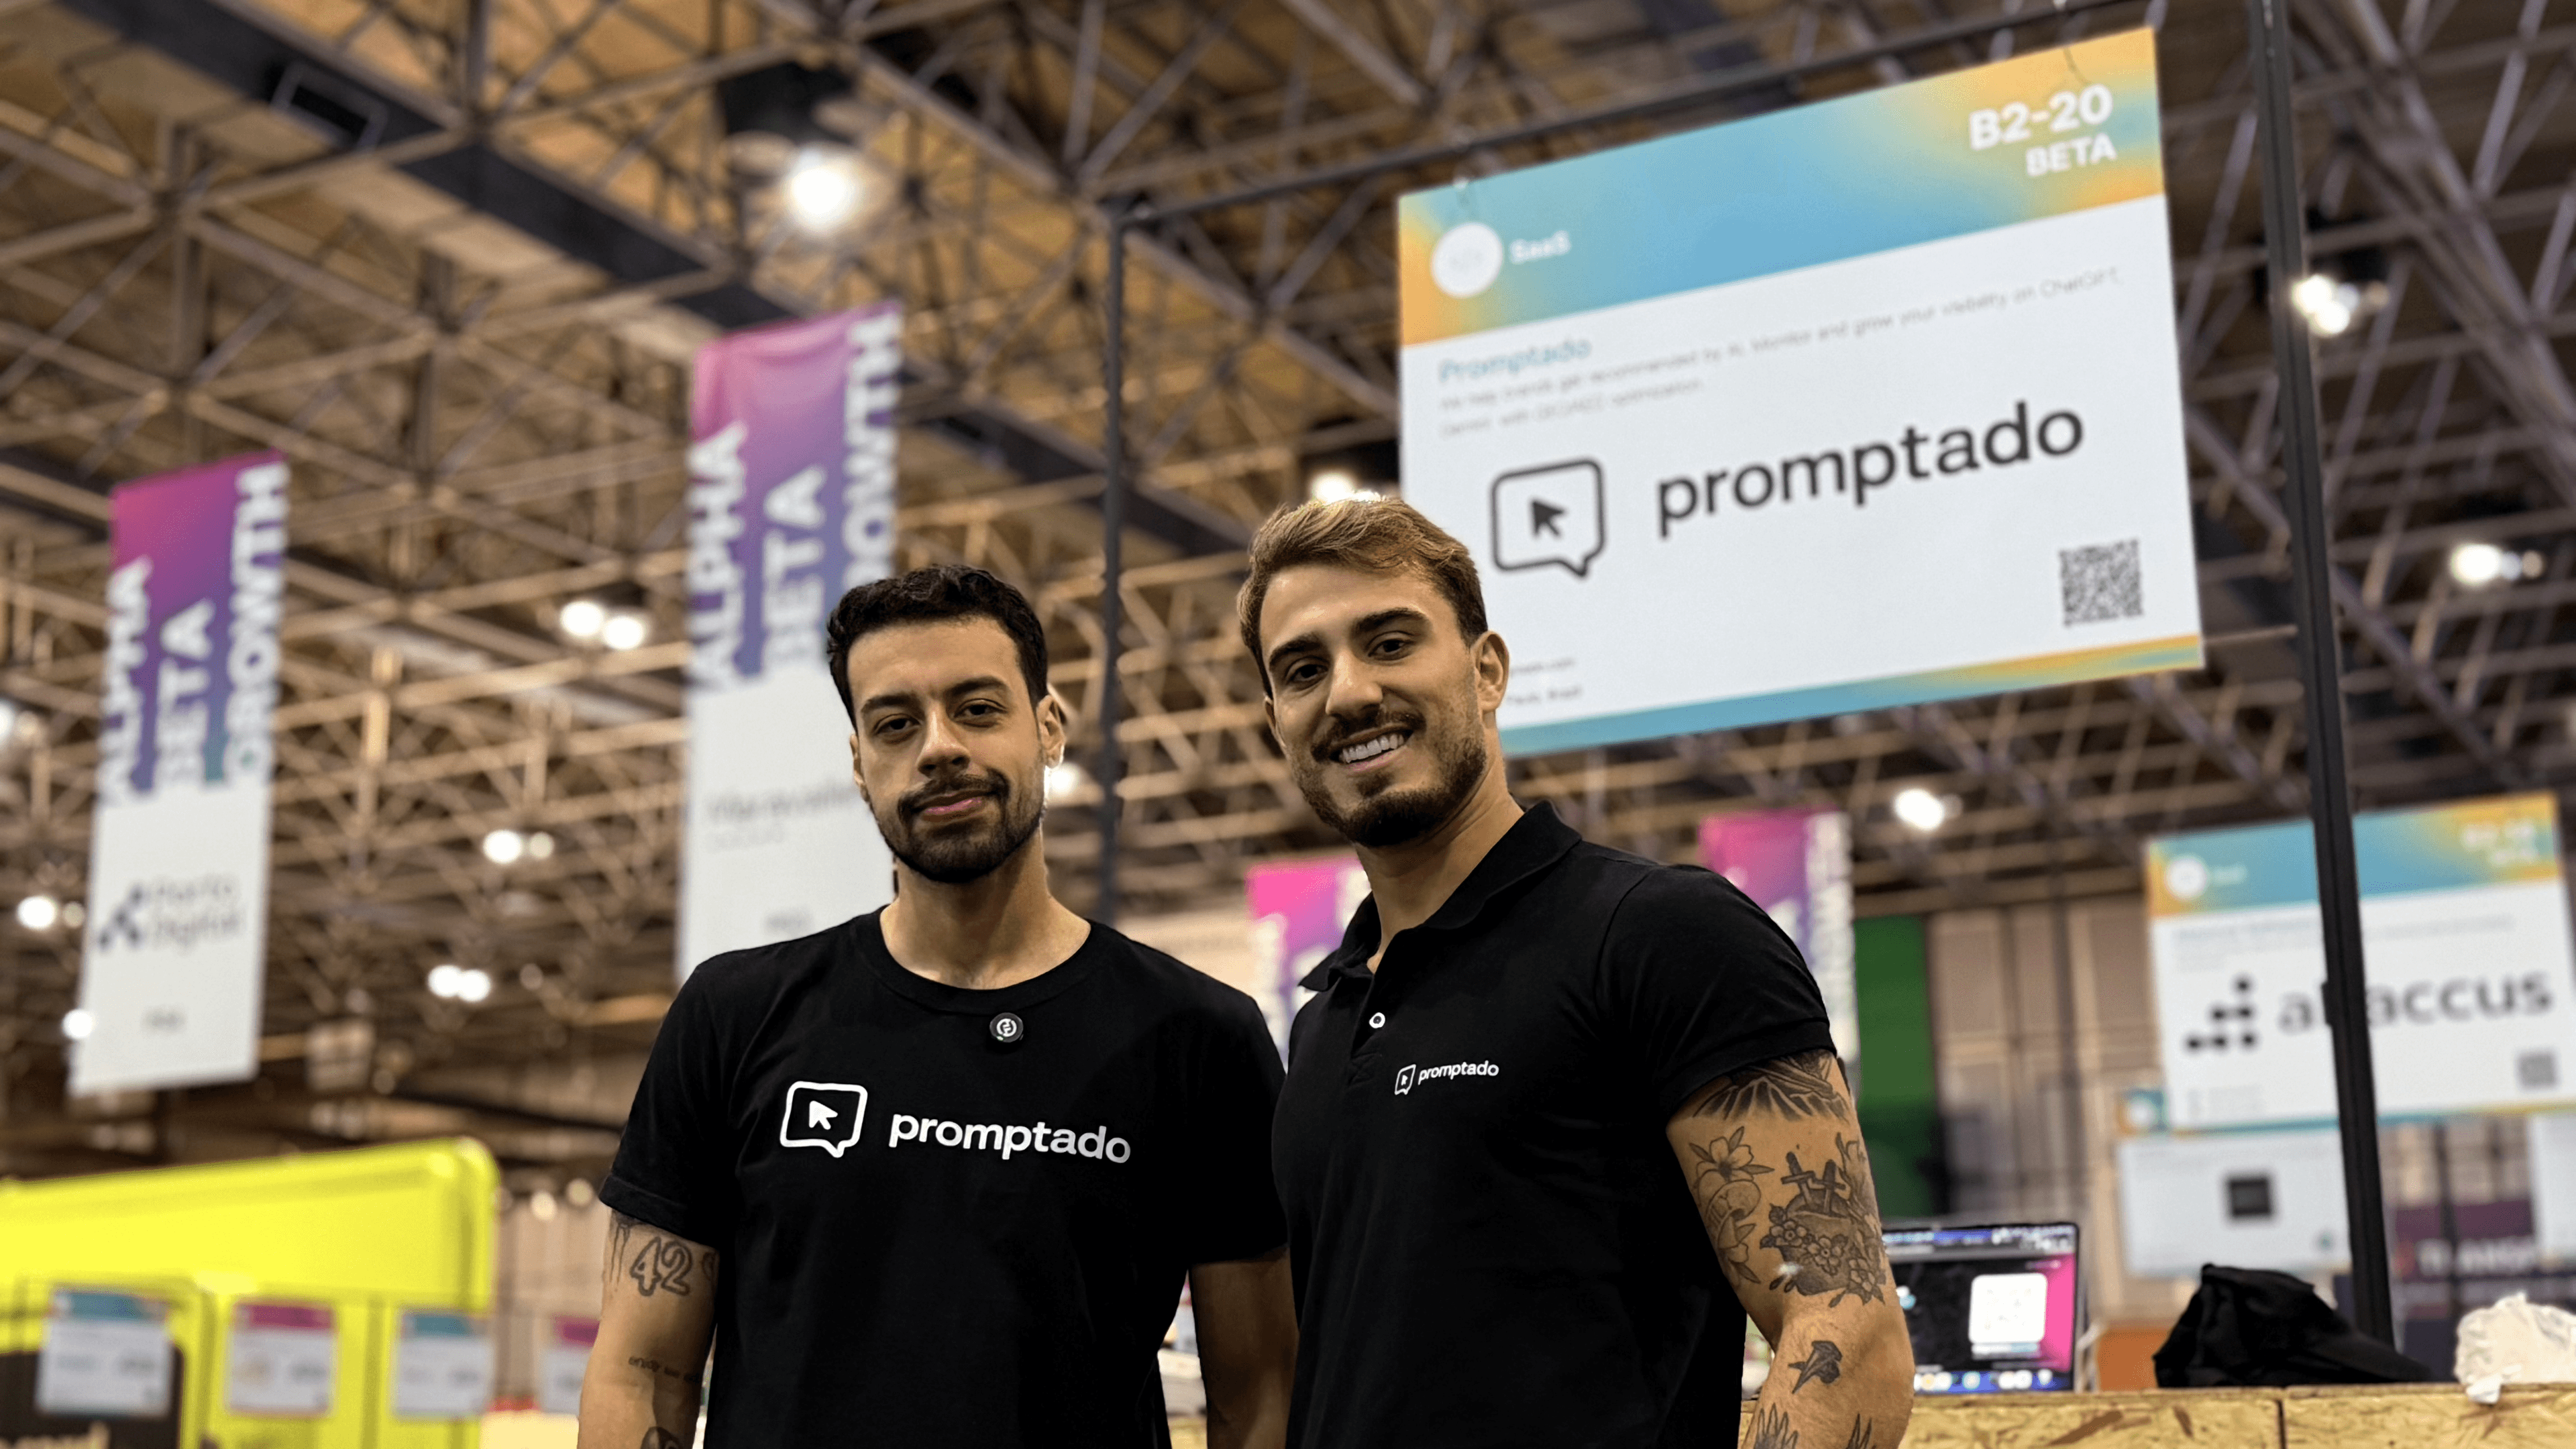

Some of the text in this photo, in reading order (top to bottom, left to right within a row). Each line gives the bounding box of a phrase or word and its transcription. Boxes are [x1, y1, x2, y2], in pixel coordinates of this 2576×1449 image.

[1970, 83, 2113, 150] B2-20
[2026, 133, 2117, 176] BETA
[1854, 315, 1894, 337] grow
[1899, 306, 1936, 329] your
[1439, 339, 1592, 383] Promptado
[1657, 400, 2083, 539] promptado
[683, 419, 748, 691] ALPHA
[761, 465, 826, 664] BETA
[96, 554, 153, 808] ALPHA
[154, 598, 217, 792] BETA
[2277, 969, 2553, 1035] aaccus
[1418, 1060, 1499, 1085] promptado
[889, 1114, 1131, 1164] promptado
[629, 1236, 693, 1297] 42
